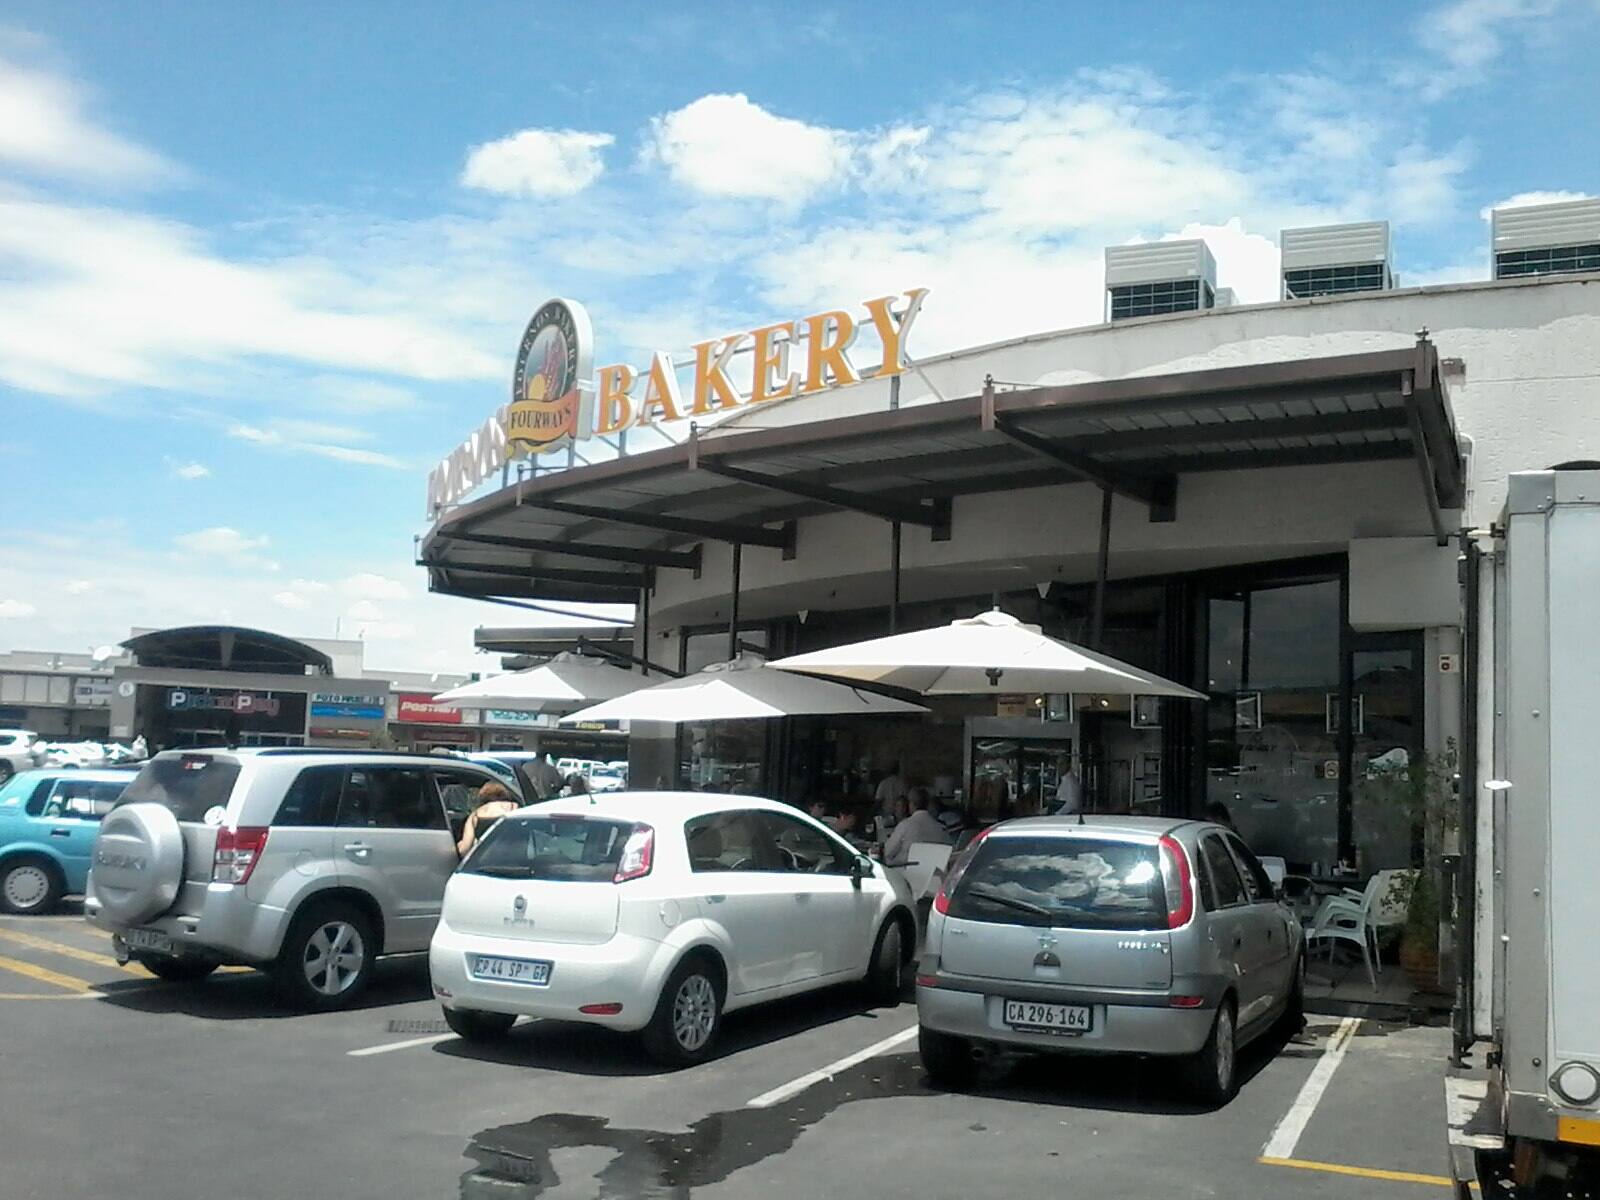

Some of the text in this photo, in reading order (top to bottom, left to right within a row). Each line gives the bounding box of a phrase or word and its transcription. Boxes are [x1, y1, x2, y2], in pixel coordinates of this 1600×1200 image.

[593, 287, 930, 436] BAKERY
[511, 408, 571, 430] FOURWAYS
[1009, 1004, 1085, 1026] CA 296-164
